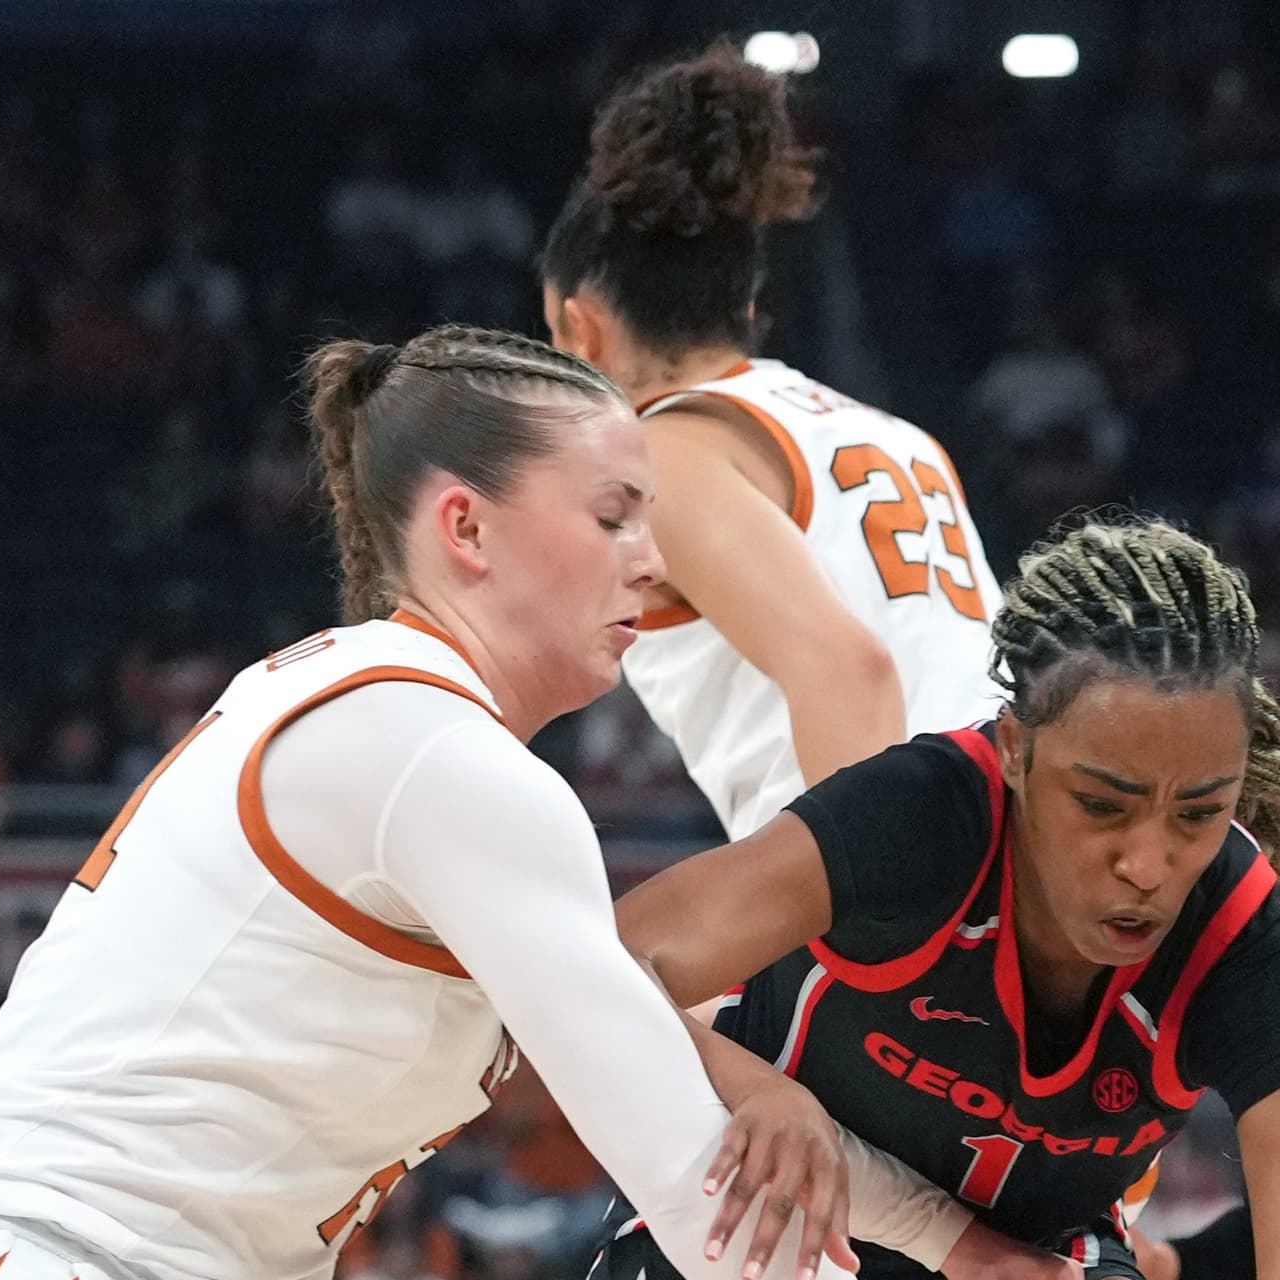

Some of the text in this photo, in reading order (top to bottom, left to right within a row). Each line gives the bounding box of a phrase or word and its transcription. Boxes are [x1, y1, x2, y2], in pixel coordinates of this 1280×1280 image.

[829, 442, 988, 623] 23
[1095, 1070, 1137, 1112] SEC
[957, 1133, 1025, 1209] 1
